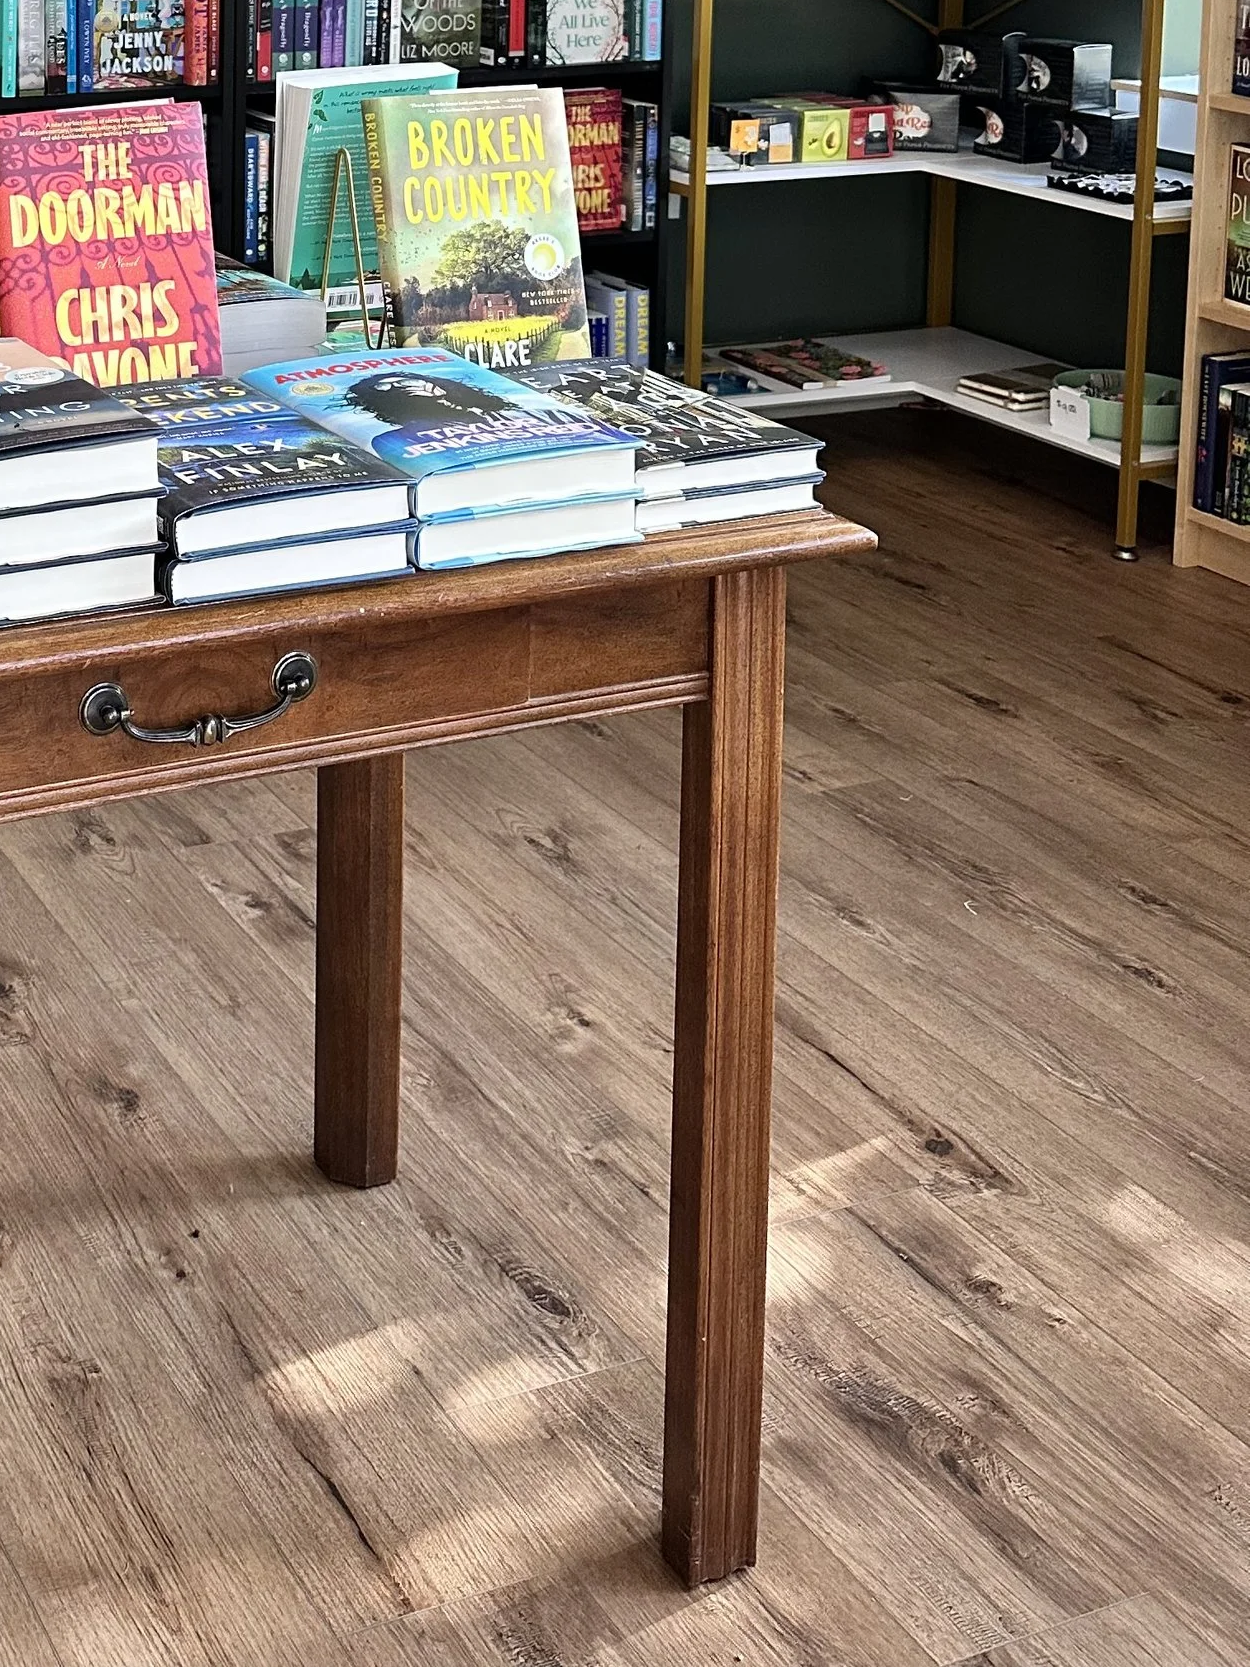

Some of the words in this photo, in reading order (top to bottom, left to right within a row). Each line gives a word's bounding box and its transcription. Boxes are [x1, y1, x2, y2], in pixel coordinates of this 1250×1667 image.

[400, 14, 476, 33] WOODS
[559, 15, 577, 29] All
[582, 13, 610, 28] Live
[114, 32, 164, 49] JENNY
[566, 33, 602, 48] Here
[101, 56, 173, 75] JACKSON
[407, 112, 547, 171] BROKEN
[78, 141, 133, 182] THE
[403, 167, 557, 225] COUNTRY
[9, 178, 207, 248] DOORMAN
[55, 279, 180, 347] CHRIS
